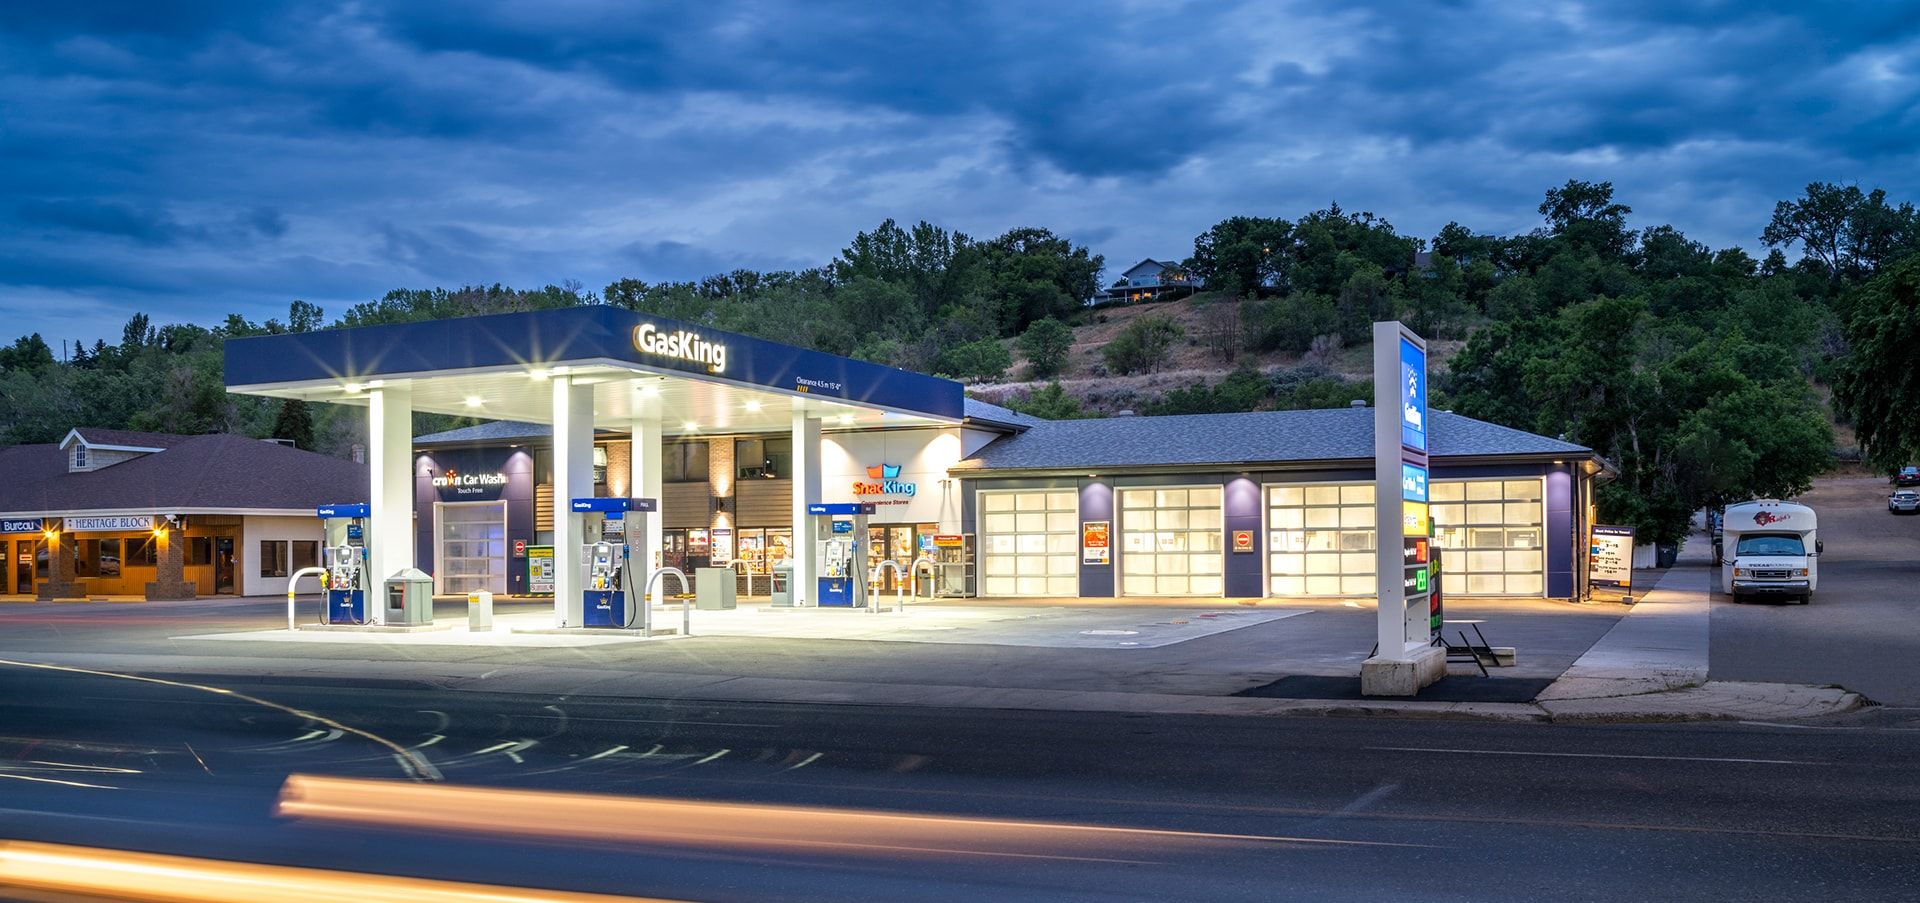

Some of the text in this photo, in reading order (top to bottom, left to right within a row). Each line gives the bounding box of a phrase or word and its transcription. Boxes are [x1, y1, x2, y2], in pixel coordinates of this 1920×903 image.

[637, 323, 726, 373] GasKing
[463, 474, 479, 485] Car
[479, 473, 507, 485] Wash
[853, 480, 916, 497] SnacKing
[4, 521, 34, 531] Bureau
[76, 516, 150, 529] HERITAGE BLOCK
